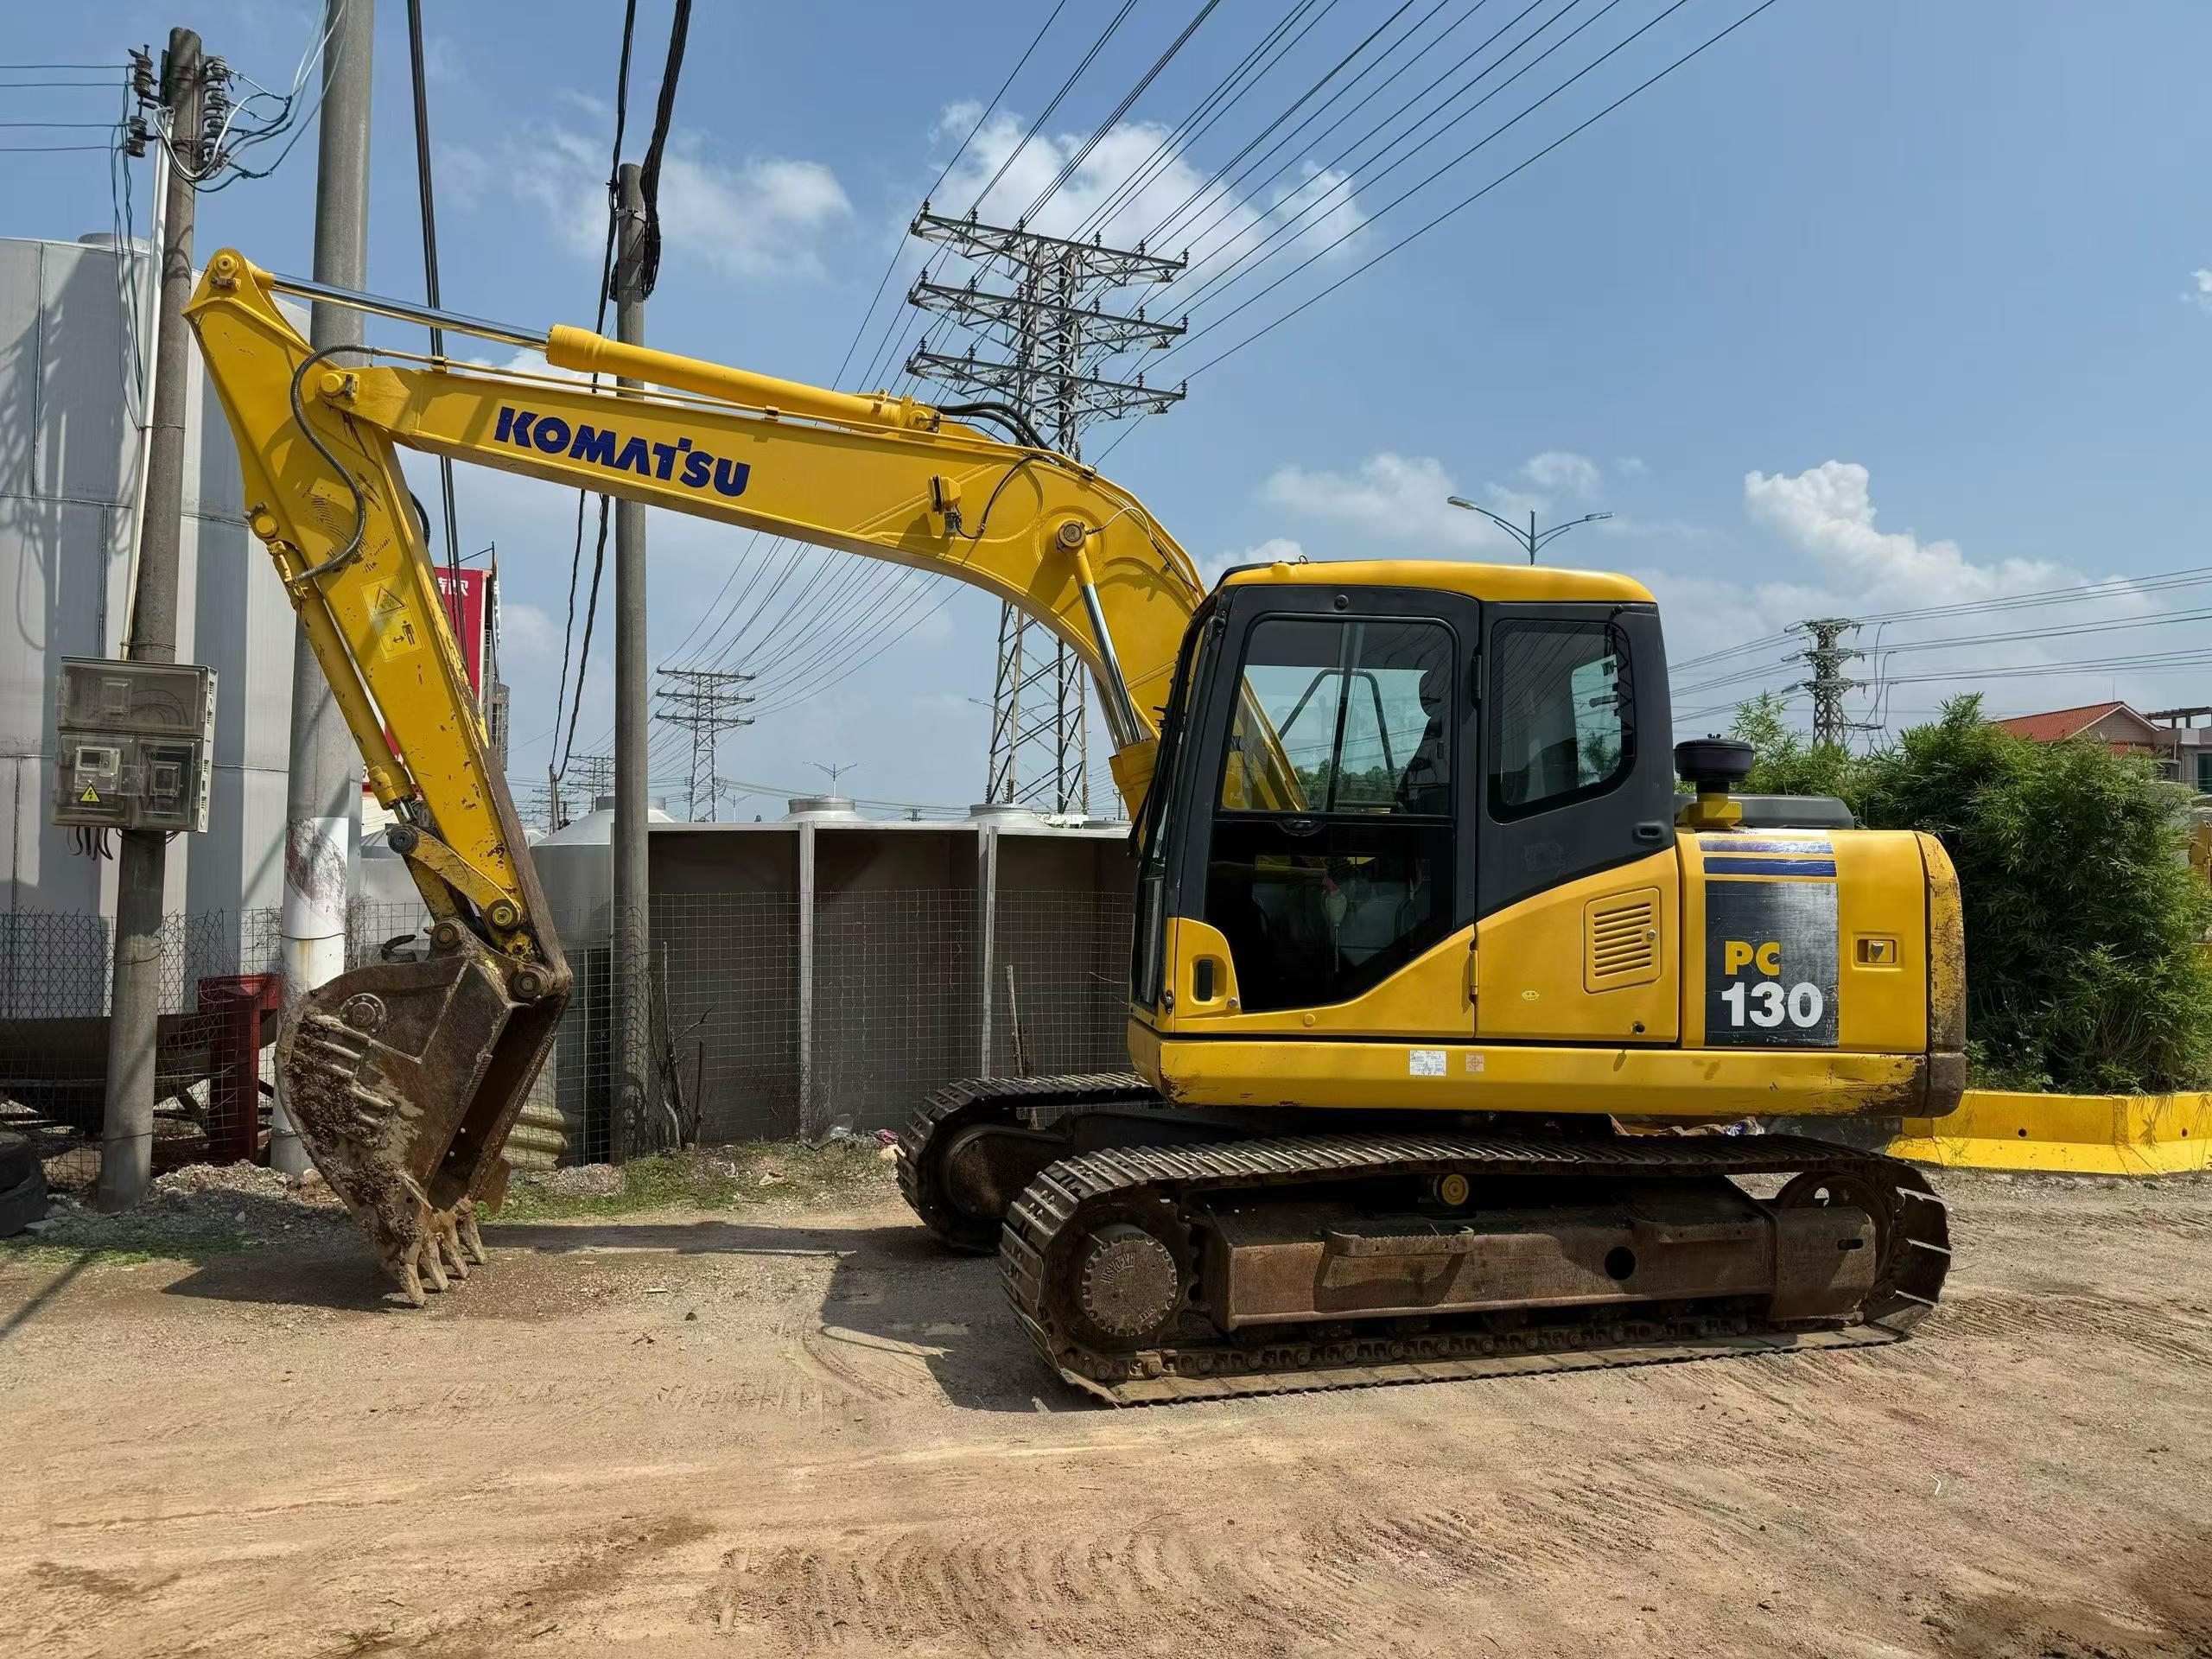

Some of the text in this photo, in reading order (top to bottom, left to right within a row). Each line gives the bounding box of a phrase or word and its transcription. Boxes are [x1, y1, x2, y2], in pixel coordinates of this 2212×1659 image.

[493, 406, 751, 497] KOMATSU
[1725, 940, 1781, 976] PC
[1721, 981, 1823, 1027] 130
